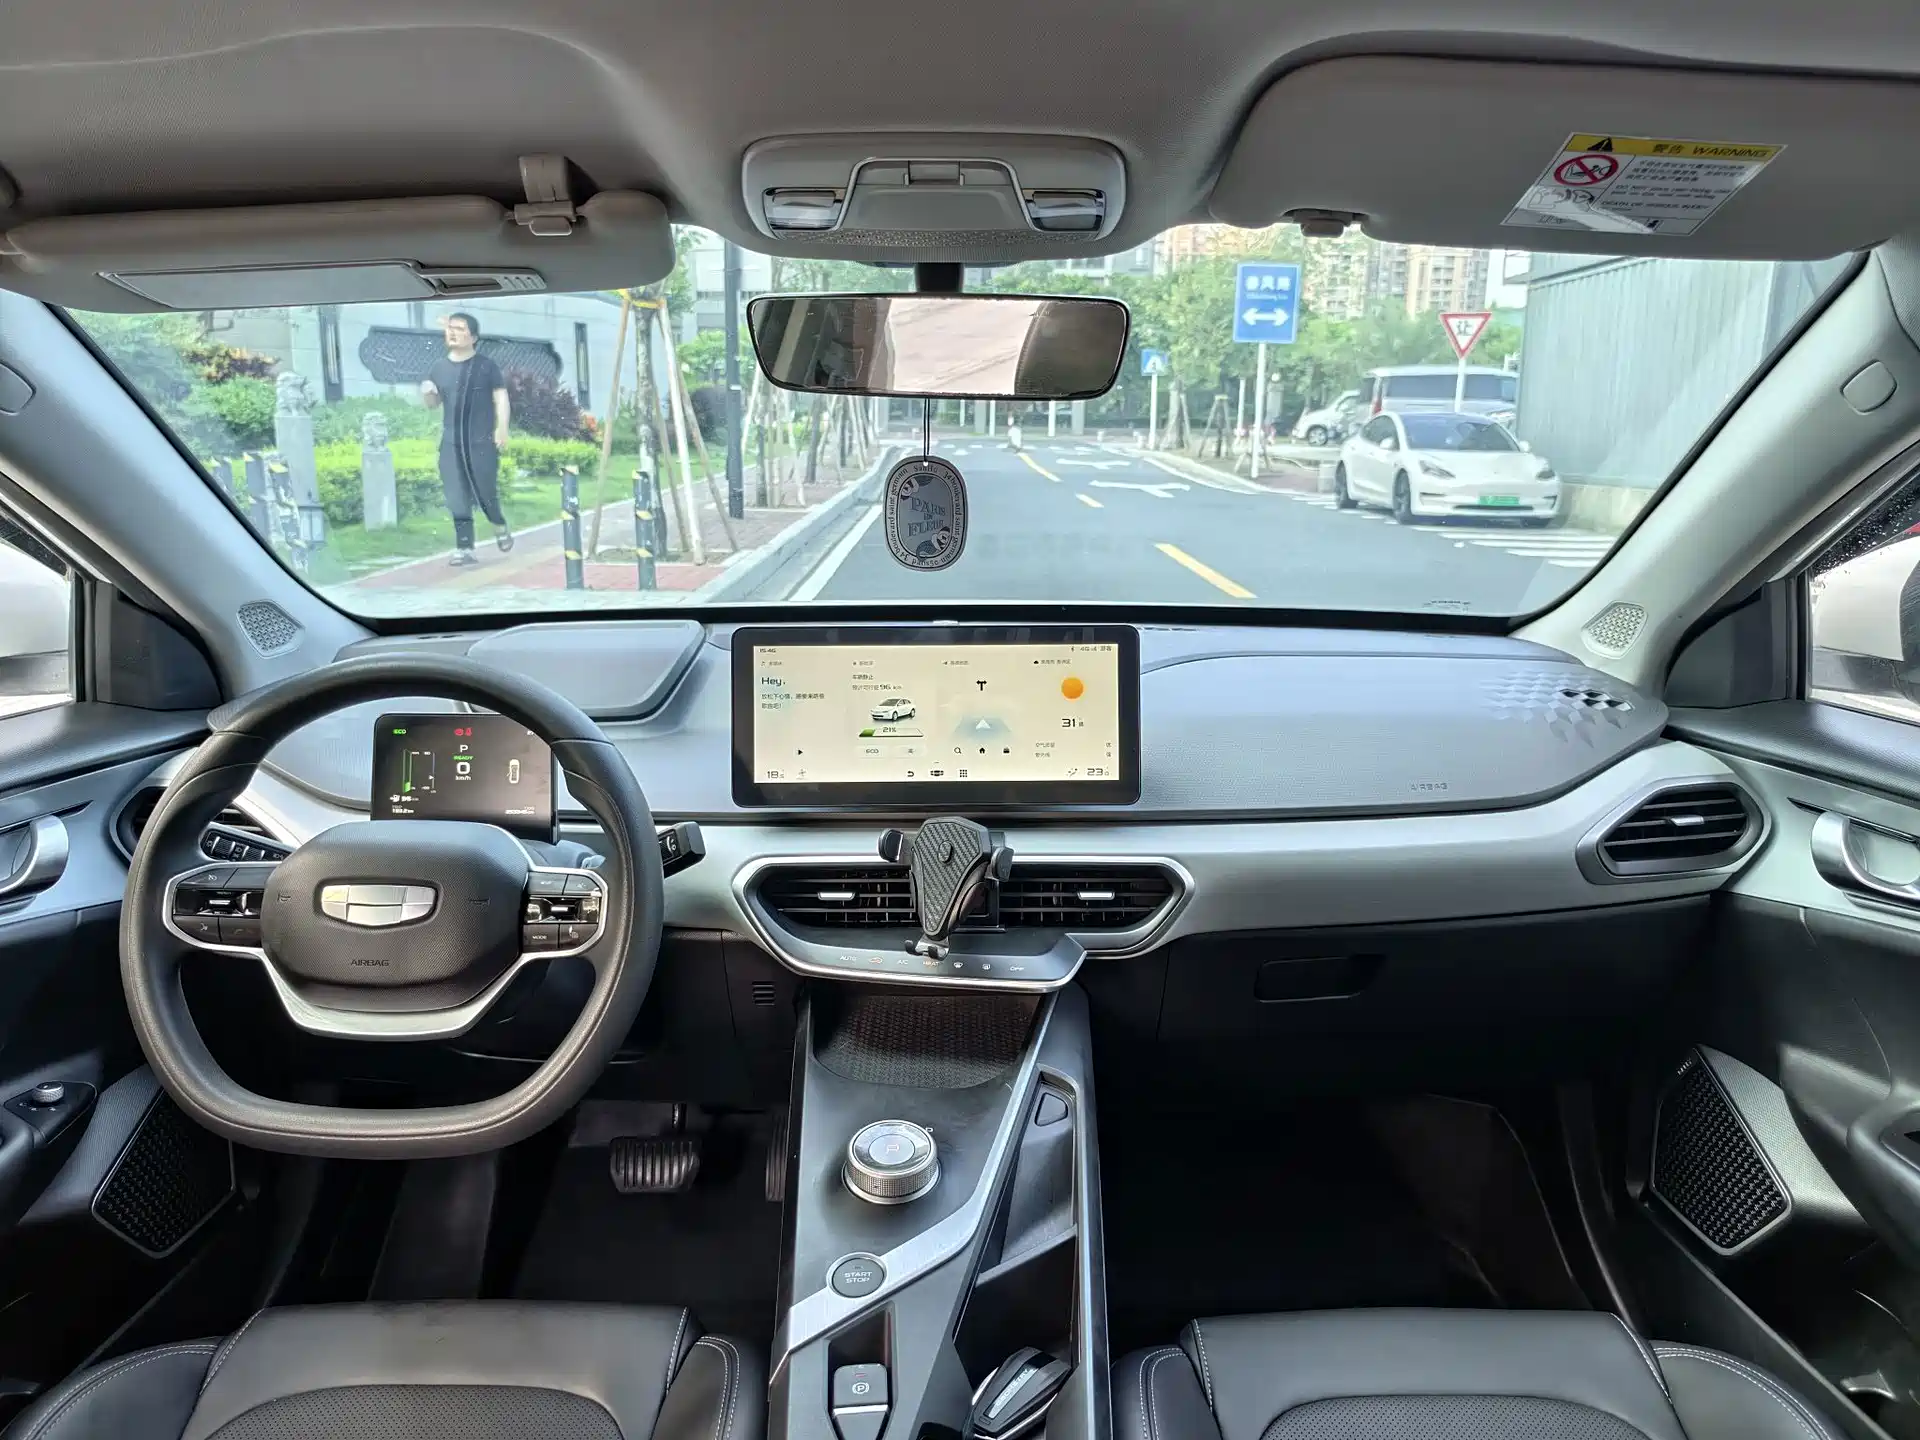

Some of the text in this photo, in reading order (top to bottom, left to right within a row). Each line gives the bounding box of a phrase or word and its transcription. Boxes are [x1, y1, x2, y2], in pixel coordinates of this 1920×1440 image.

[1692, 145, 1767, 158] WARNING
[1456, 320, 1473, 336] 让
[1061, 718, 1076, 728] 31
[459, 744, 469, 753] P
[456, 761, 471, 775] 0
[350, 958, 390, 967] AIRBAG
